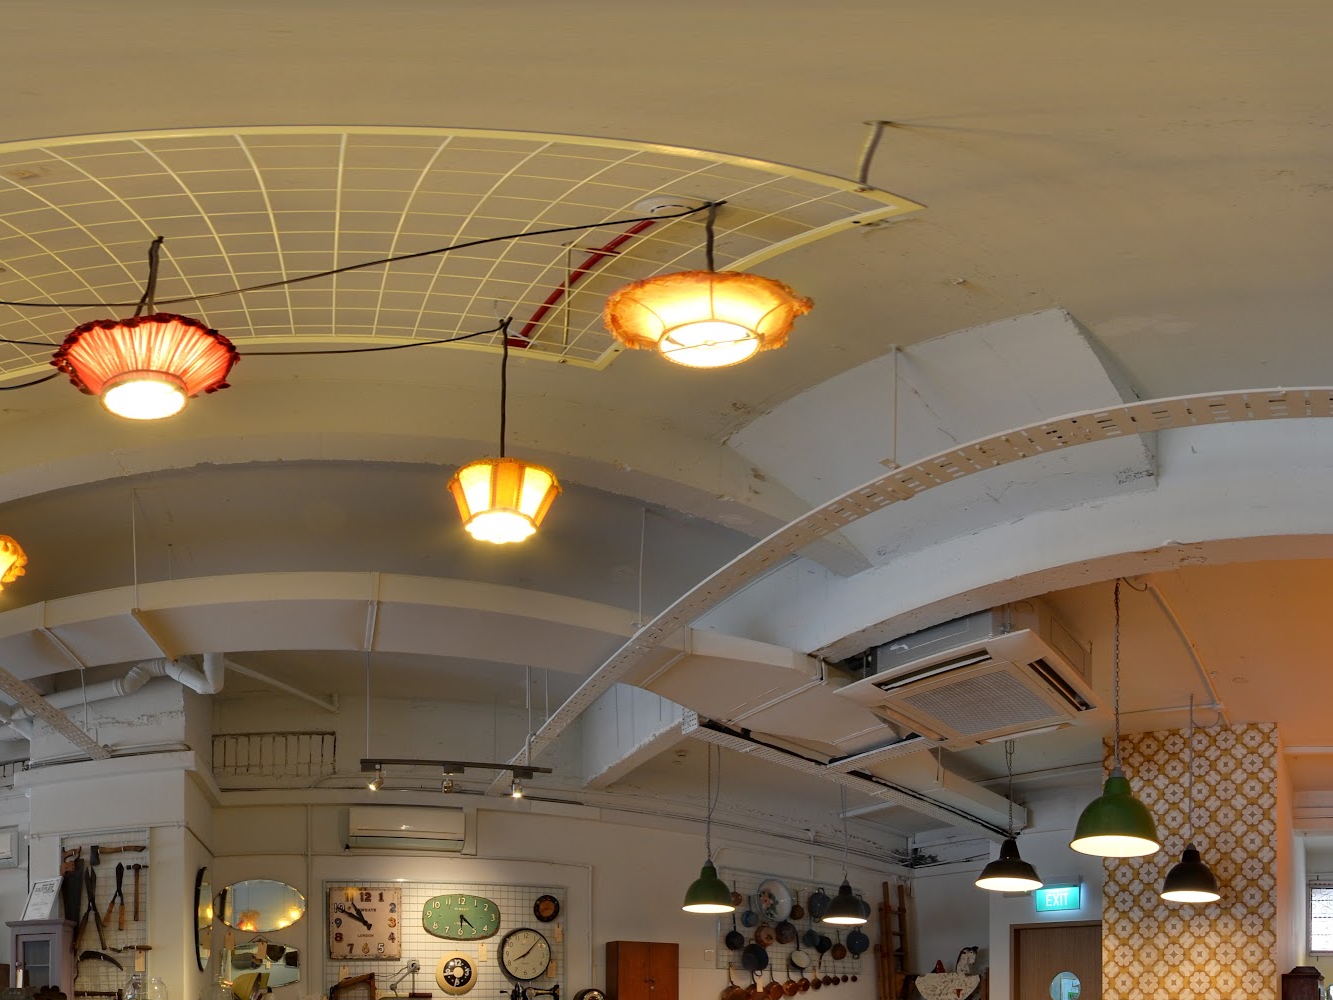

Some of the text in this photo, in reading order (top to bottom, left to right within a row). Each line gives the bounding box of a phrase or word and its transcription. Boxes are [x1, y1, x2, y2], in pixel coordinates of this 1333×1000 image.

[360, 892, 372, 902] 12
[378, 892, 384, 902] 1
[1046, 892, 1070, 906] EXIT
[389, 903, 396, 913] 2
[335, 918, 343, 928] 9
[388, 917, 396, 928] 3
[335, 933, 343, 943] 8
[388, 933, 396, 943] 4
[347, 944, 354, 954] 7
[362, 943, 370, 954] 6
[377, 943, 385, 953] 5
[454, 959, 462, 967] 12
